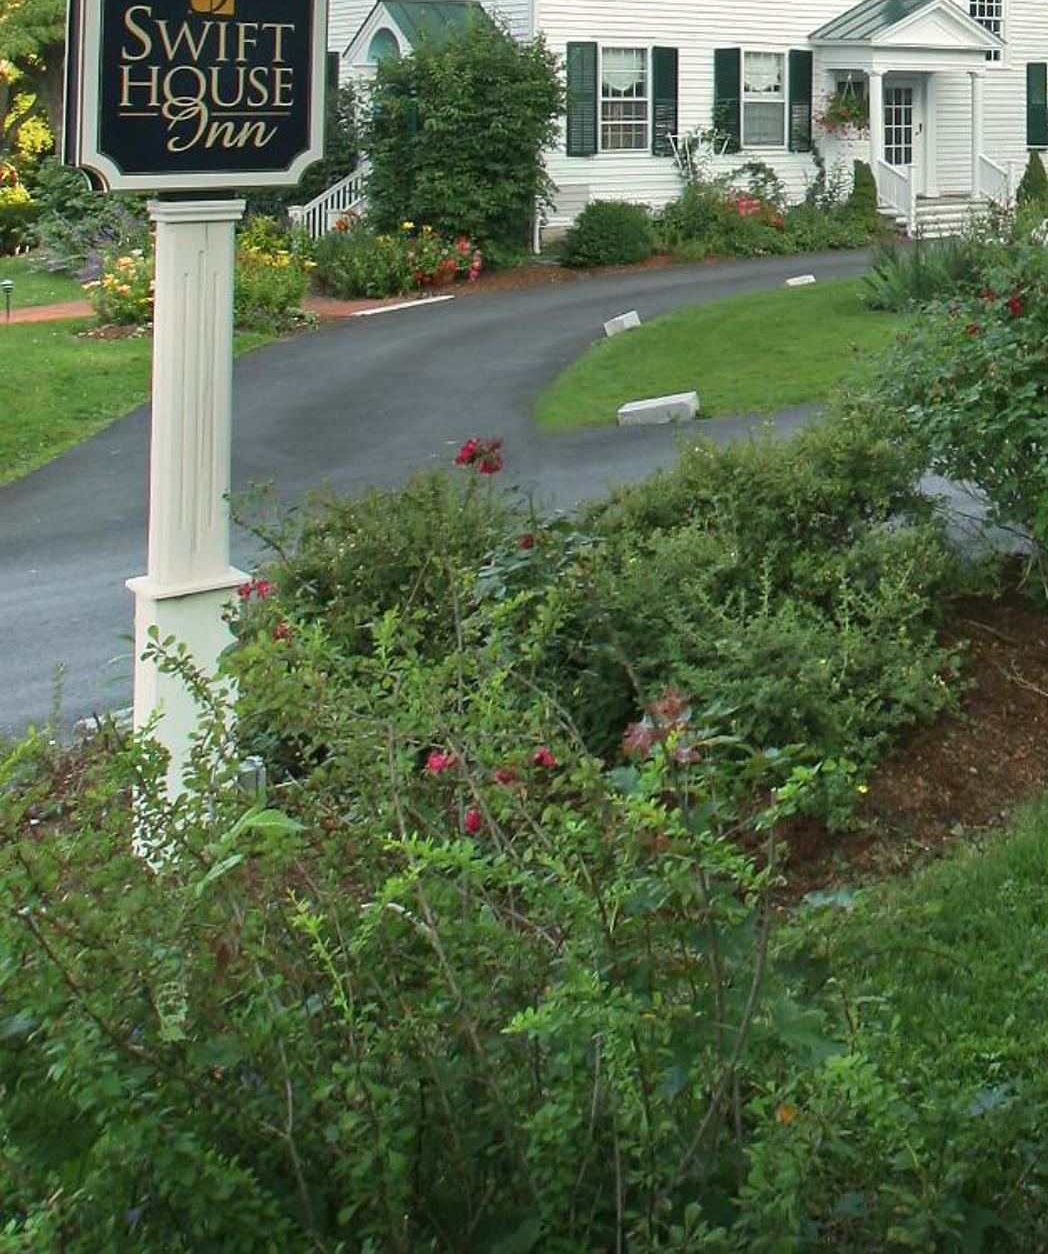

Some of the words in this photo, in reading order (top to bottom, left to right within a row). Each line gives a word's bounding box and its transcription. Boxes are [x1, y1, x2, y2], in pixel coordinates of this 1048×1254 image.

[121, 5, 295, 63] SWIFT
[119, 65, 294, 108] HOUSE
[162, 96, 278, 152] Inn
